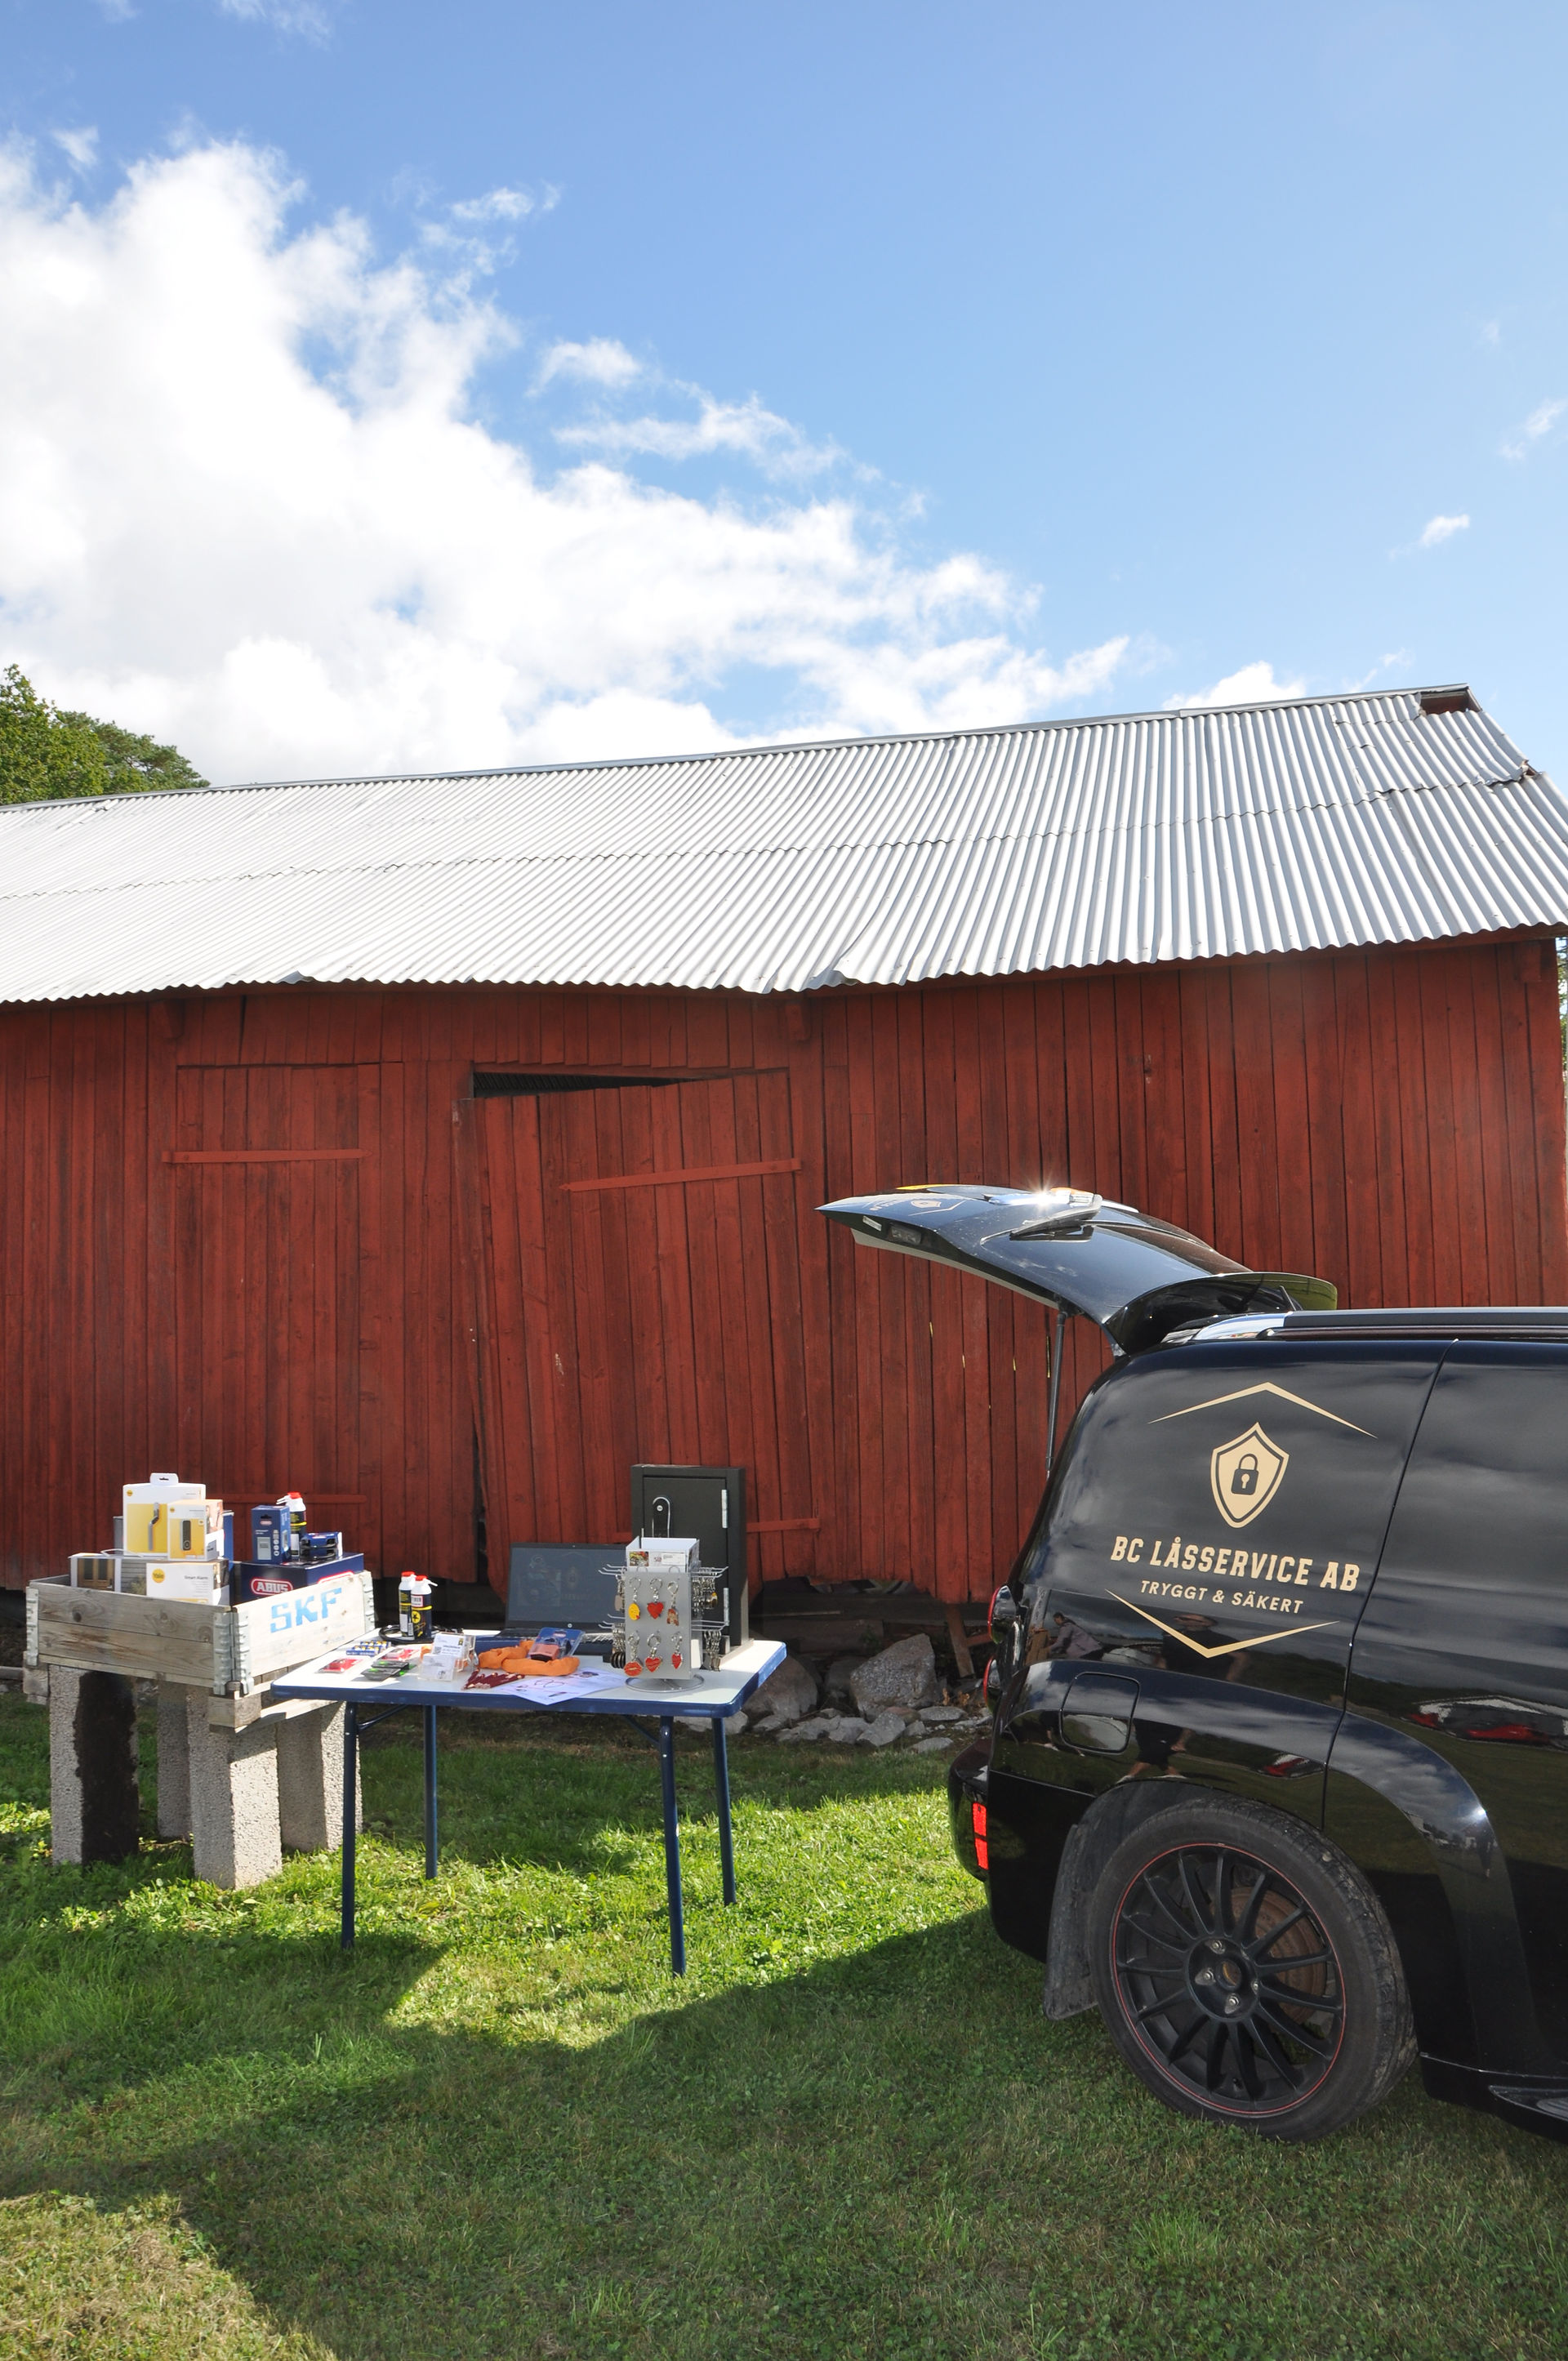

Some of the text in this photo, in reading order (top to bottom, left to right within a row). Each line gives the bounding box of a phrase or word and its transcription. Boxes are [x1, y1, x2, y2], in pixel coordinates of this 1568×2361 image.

[1111, 1535, 1360, 1592] BC LÅSSERVICE AB
[256, 1581, 288, 1594] ABUS
[1141, 1580, 1304, 1614] TRYGGT & SÄKERT
[270, 1587, 342, 1633] SKF
